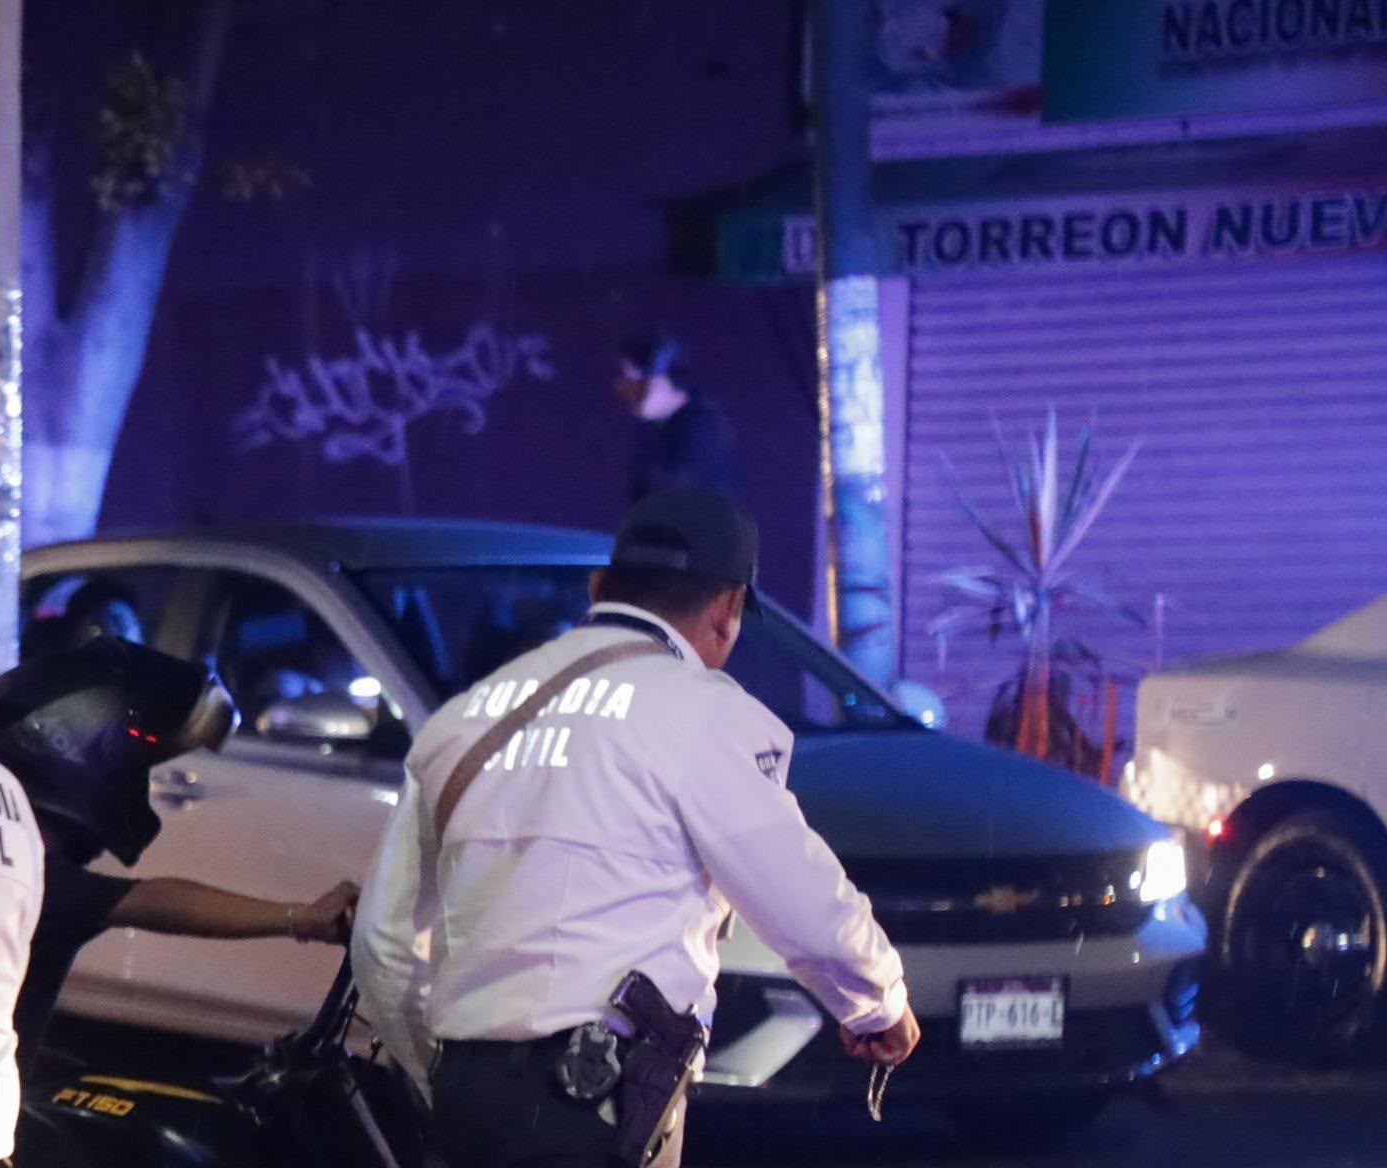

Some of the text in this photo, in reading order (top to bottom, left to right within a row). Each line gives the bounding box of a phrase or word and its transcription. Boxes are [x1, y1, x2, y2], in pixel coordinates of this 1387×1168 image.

[1163, 0, 1387, 51] NACIONA
[897, 207, 1187, 265] TORREON
[51, 1087, 137, 1117] FT150
